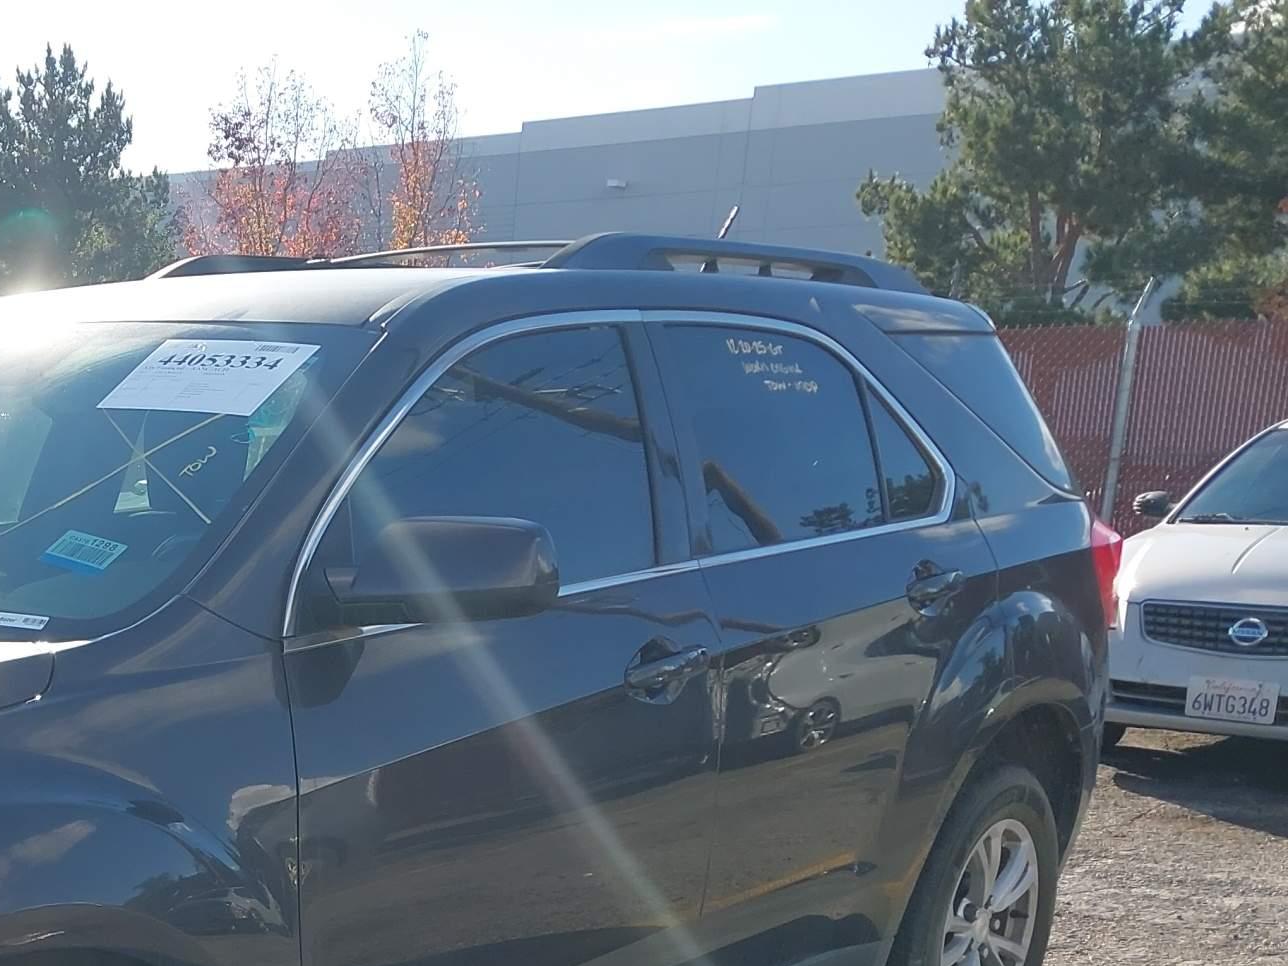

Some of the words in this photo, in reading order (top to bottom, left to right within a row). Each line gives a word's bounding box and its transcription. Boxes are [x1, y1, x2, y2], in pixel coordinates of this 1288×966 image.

[158, 353, 283, 370] 44053334
[178, 446, 217, 477] TOW
[1192, 692, 1270, 718] 6WTG348
